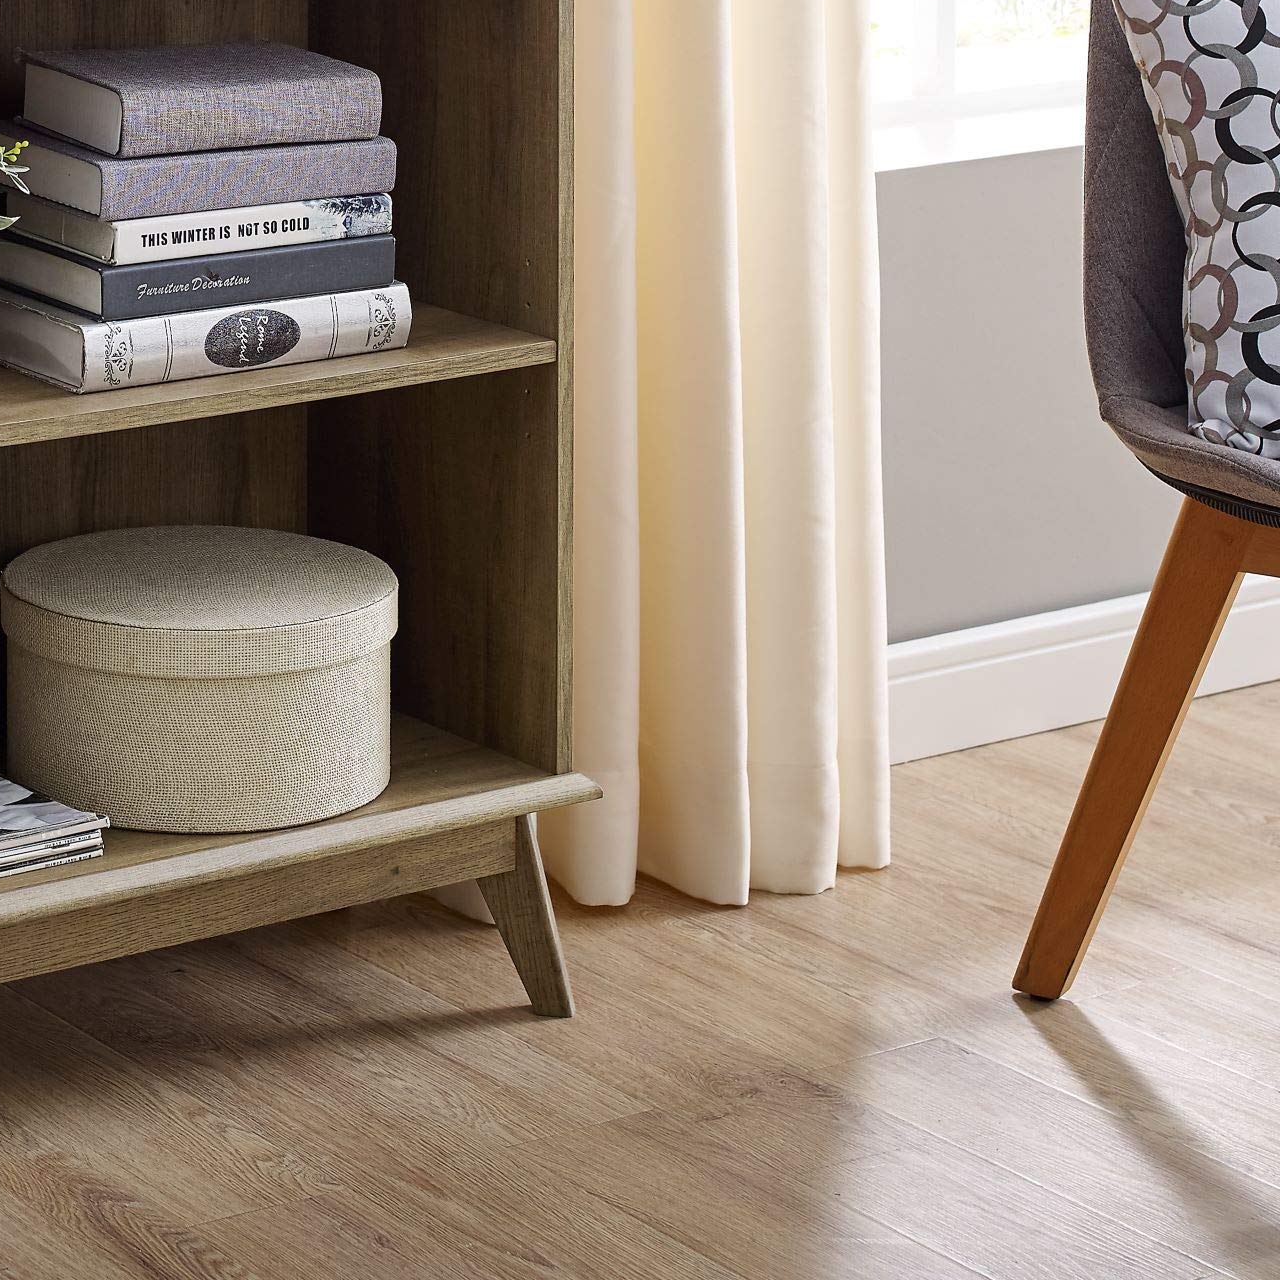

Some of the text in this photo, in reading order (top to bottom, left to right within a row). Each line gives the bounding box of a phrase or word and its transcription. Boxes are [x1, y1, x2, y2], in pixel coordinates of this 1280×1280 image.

[141, 217, 310, 248] THIS WINTER IS NOT SO COLD
[136, 275, 251, 300] Furniture Decoration
[256, 315, 269, 353] Rome
